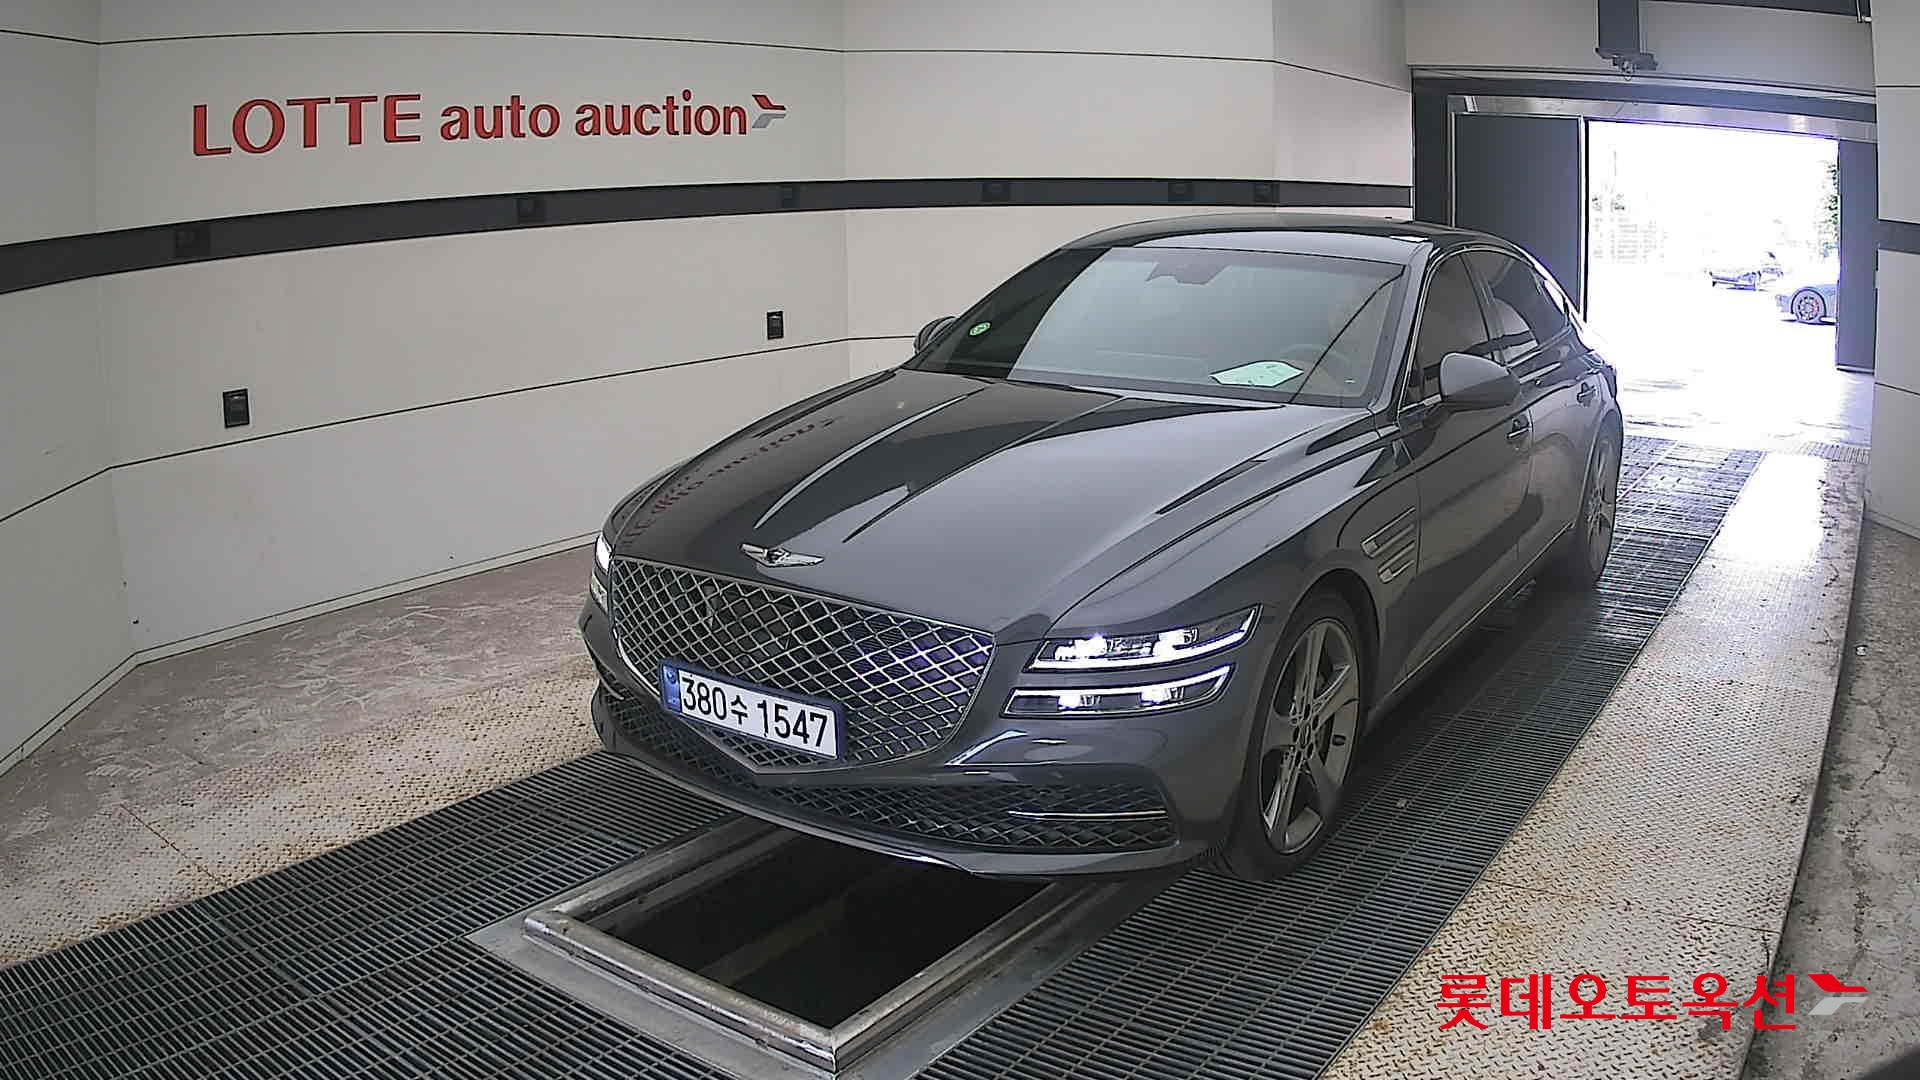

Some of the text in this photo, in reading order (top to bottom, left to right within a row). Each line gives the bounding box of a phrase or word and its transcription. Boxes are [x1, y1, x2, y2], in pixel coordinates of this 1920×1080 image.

[193, 89, 748, 157] LOTTE auto auction
[681, 677, 829, 748] 380수 1547
